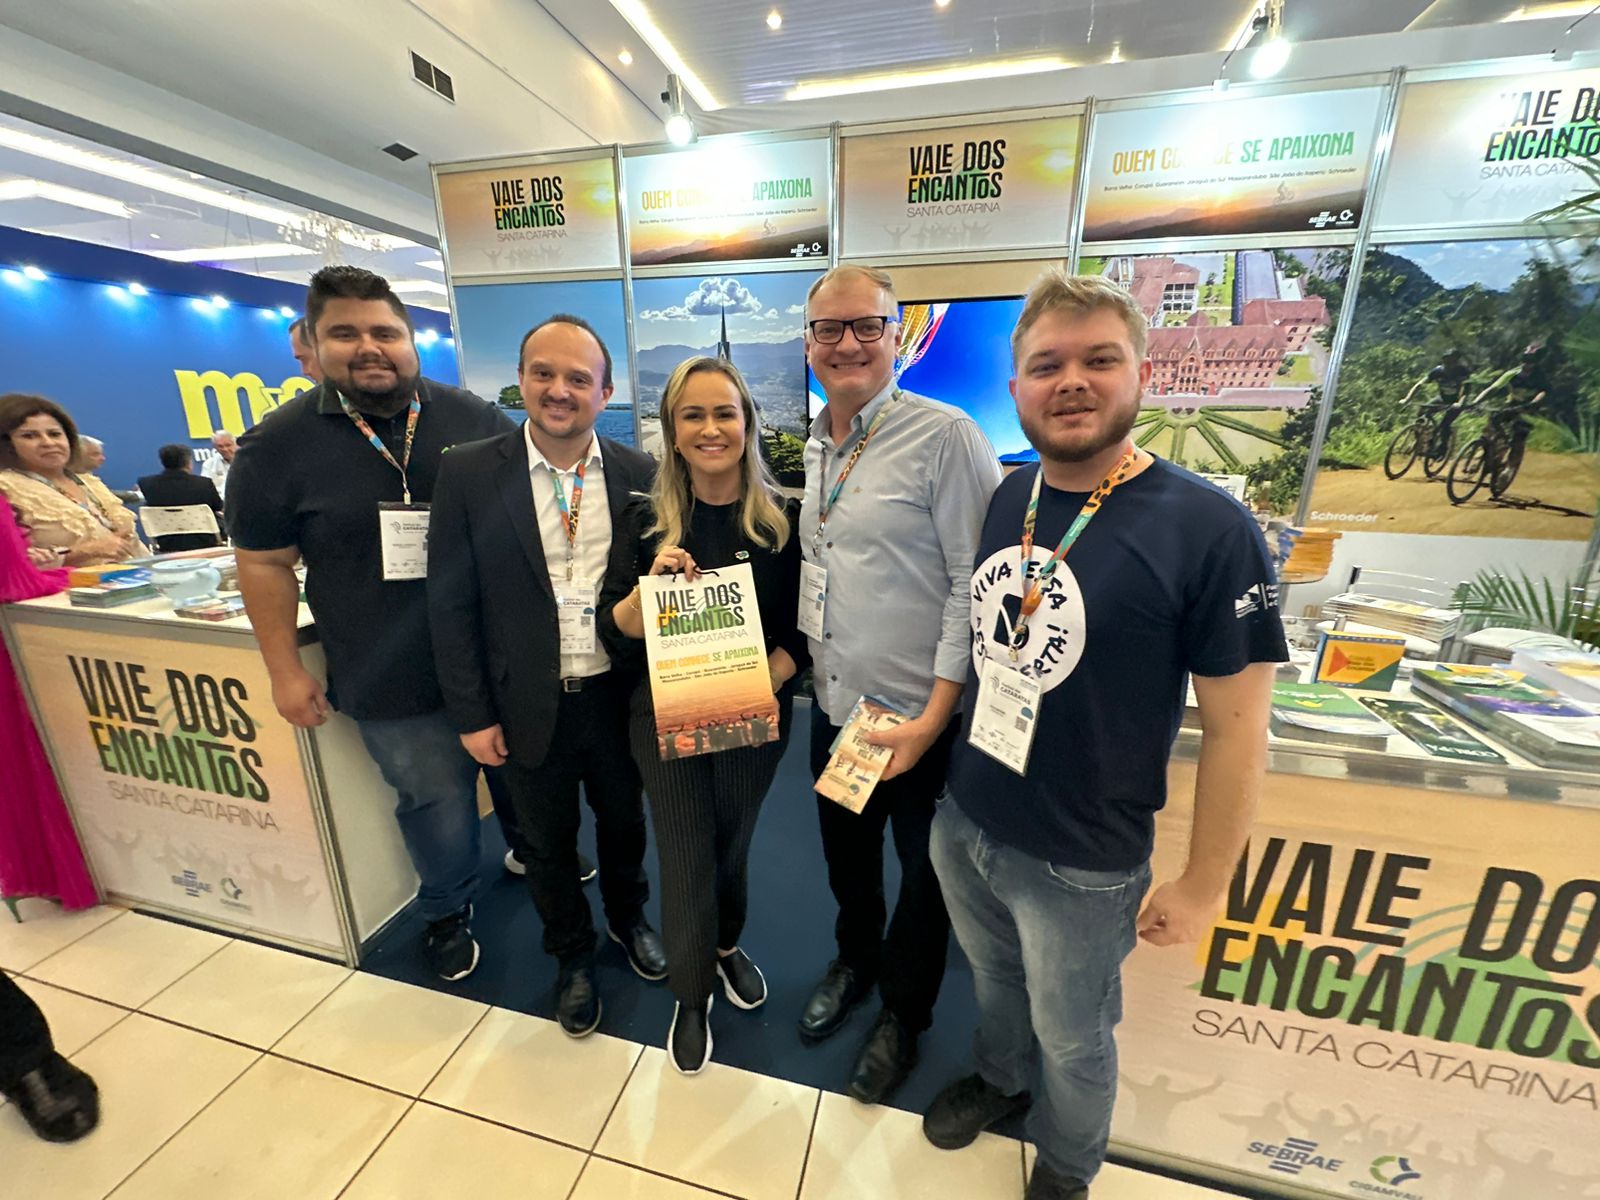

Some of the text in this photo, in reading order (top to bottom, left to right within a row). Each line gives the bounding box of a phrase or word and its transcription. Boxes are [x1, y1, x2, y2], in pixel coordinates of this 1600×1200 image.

[1500, 87, 1600, 127] ALE D
[909, 139, 1006, 176] VALE DOS
[1112, 149, 1156, 176] QUEM
[1240, 139, 1263, 163] SE
[1267, 131, 1355, 161] APAIXONA
[907, 171, 1003, 204] ENCANTOS
[1480, 164, 1532, 180] SANTA
[491, 176, 563, 206] VALE DOS
[642, 191, 672, 211] QUEM
[753, 177, 812, 201] APAIXONA
[494, 203, 565, 230] ENCANTOS
[906, 202, 1001, 218] SANTA CATARINA
[497, 229, 567, 242] SANTA CATARINA
[1311, 510, 1379, 522] Schroeder
[655, 582, 742, 614] VALE DOS
[973, 562, 1012, 602] VIVA
[658, 606, 745, 637] ENCANTOS
[660, 628, 748, 650] SANTA CATARINA
[712, 651, 721, 662] SE
[724, 646, 759, 661] APAIXONA
[67, 655, 256, 742] VALE DOS
[89, 720, 270, 803] ENCANTOS
[106, 780, 281, 833] SANTA CATARINA
[172, 875, 213, 893] SEBRAE
[1226, 834, 1431, 948] VALE
[1192, 1009, 1600, 1110] SANTA CATARINA
[1247, 1141, 1344, 1172] SEBRAE
